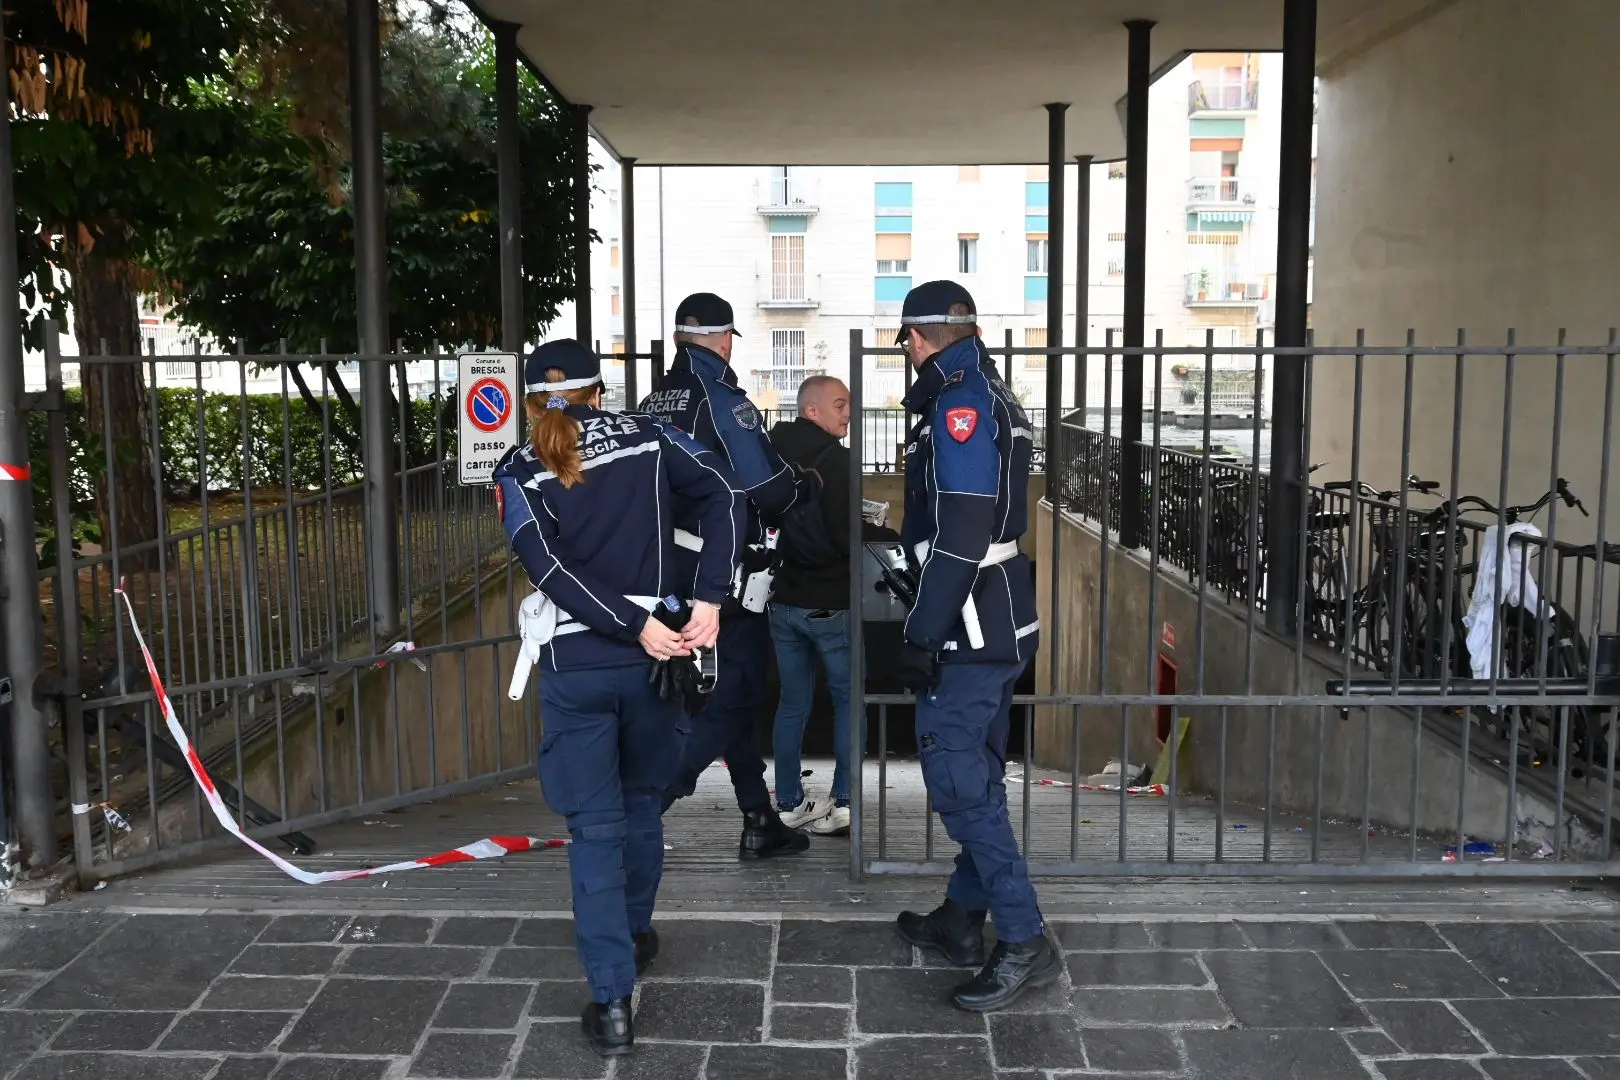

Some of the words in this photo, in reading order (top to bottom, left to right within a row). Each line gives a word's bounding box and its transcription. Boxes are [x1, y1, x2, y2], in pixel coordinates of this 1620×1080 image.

[471, 366, 506, 375] BRESCIA
[640, 399, 689, 413] LOCALE
[473, 441, 506, 453] passo
[577, 439, 620, 460] ESCIA
[804, 801, 816, 813] N
